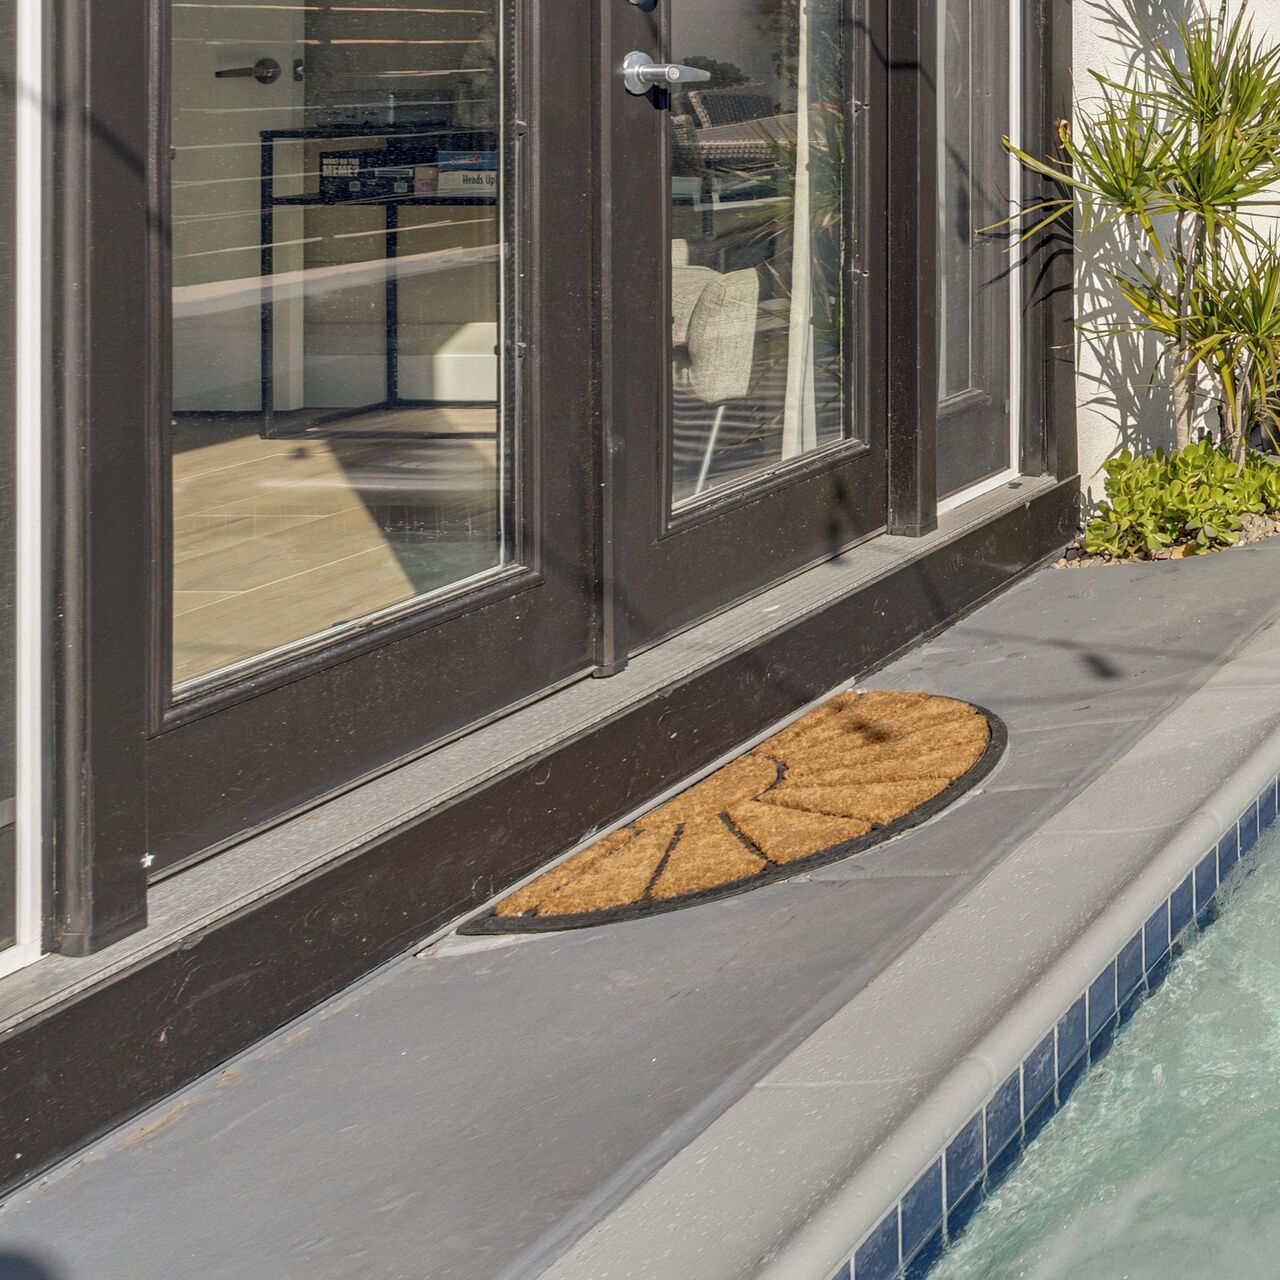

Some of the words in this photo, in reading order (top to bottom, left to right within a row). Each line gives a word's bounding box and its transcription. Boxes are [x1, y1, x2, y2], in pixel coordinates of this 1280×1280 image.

[322, 165, 360, 177] MEME?
[462, 174, 484, 185] Heads
[485, 174, 497, 187] Up
